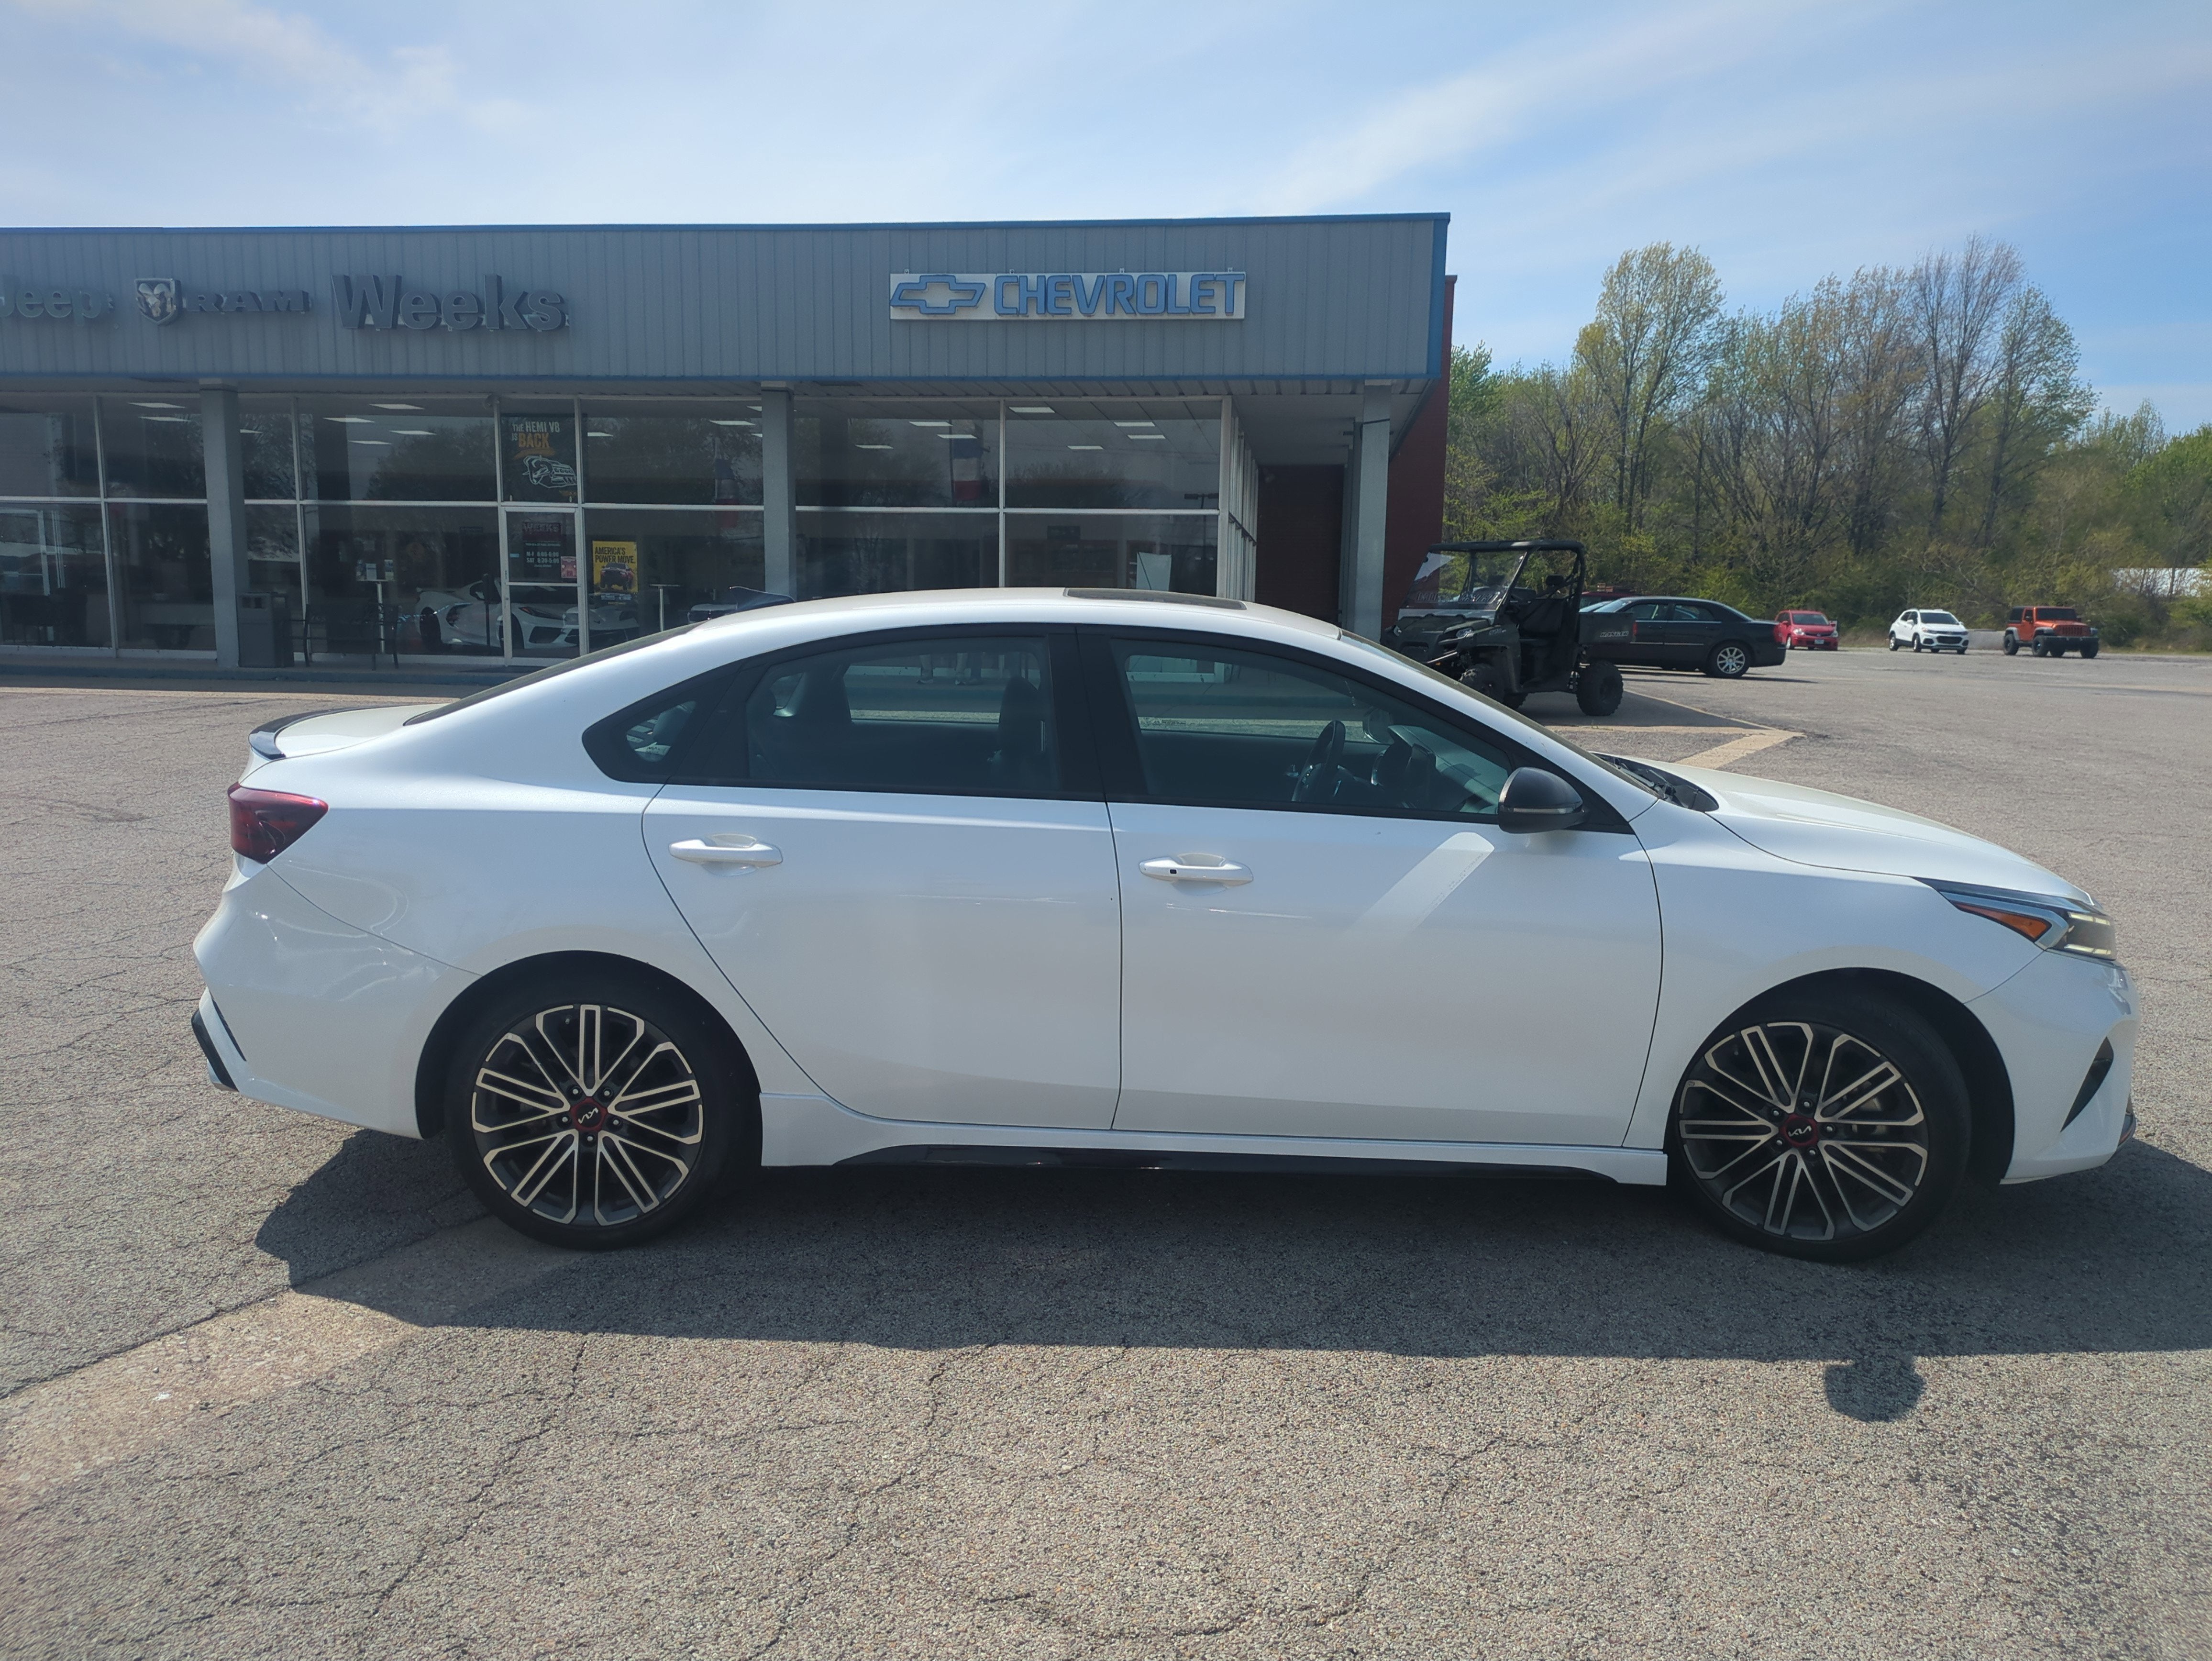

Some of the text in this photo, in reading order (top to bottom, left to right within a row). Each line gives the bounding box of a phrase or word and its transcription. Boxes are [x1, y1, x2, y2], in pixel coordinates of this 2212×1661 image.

[0, 275, 102, 326] Jeep
[185, 290, 310, 312] RAM
[331, 274, 565, 330] Weeks
[994, 274, 1245, 315] CHEVROLET
[512, 421, 560, 432] THE HEMI V8
[511, 432, 550, 448] IS BACK
[595, 546, 626, 554] AMERICA'S
[618, 555, 636, 564] MOVE.
